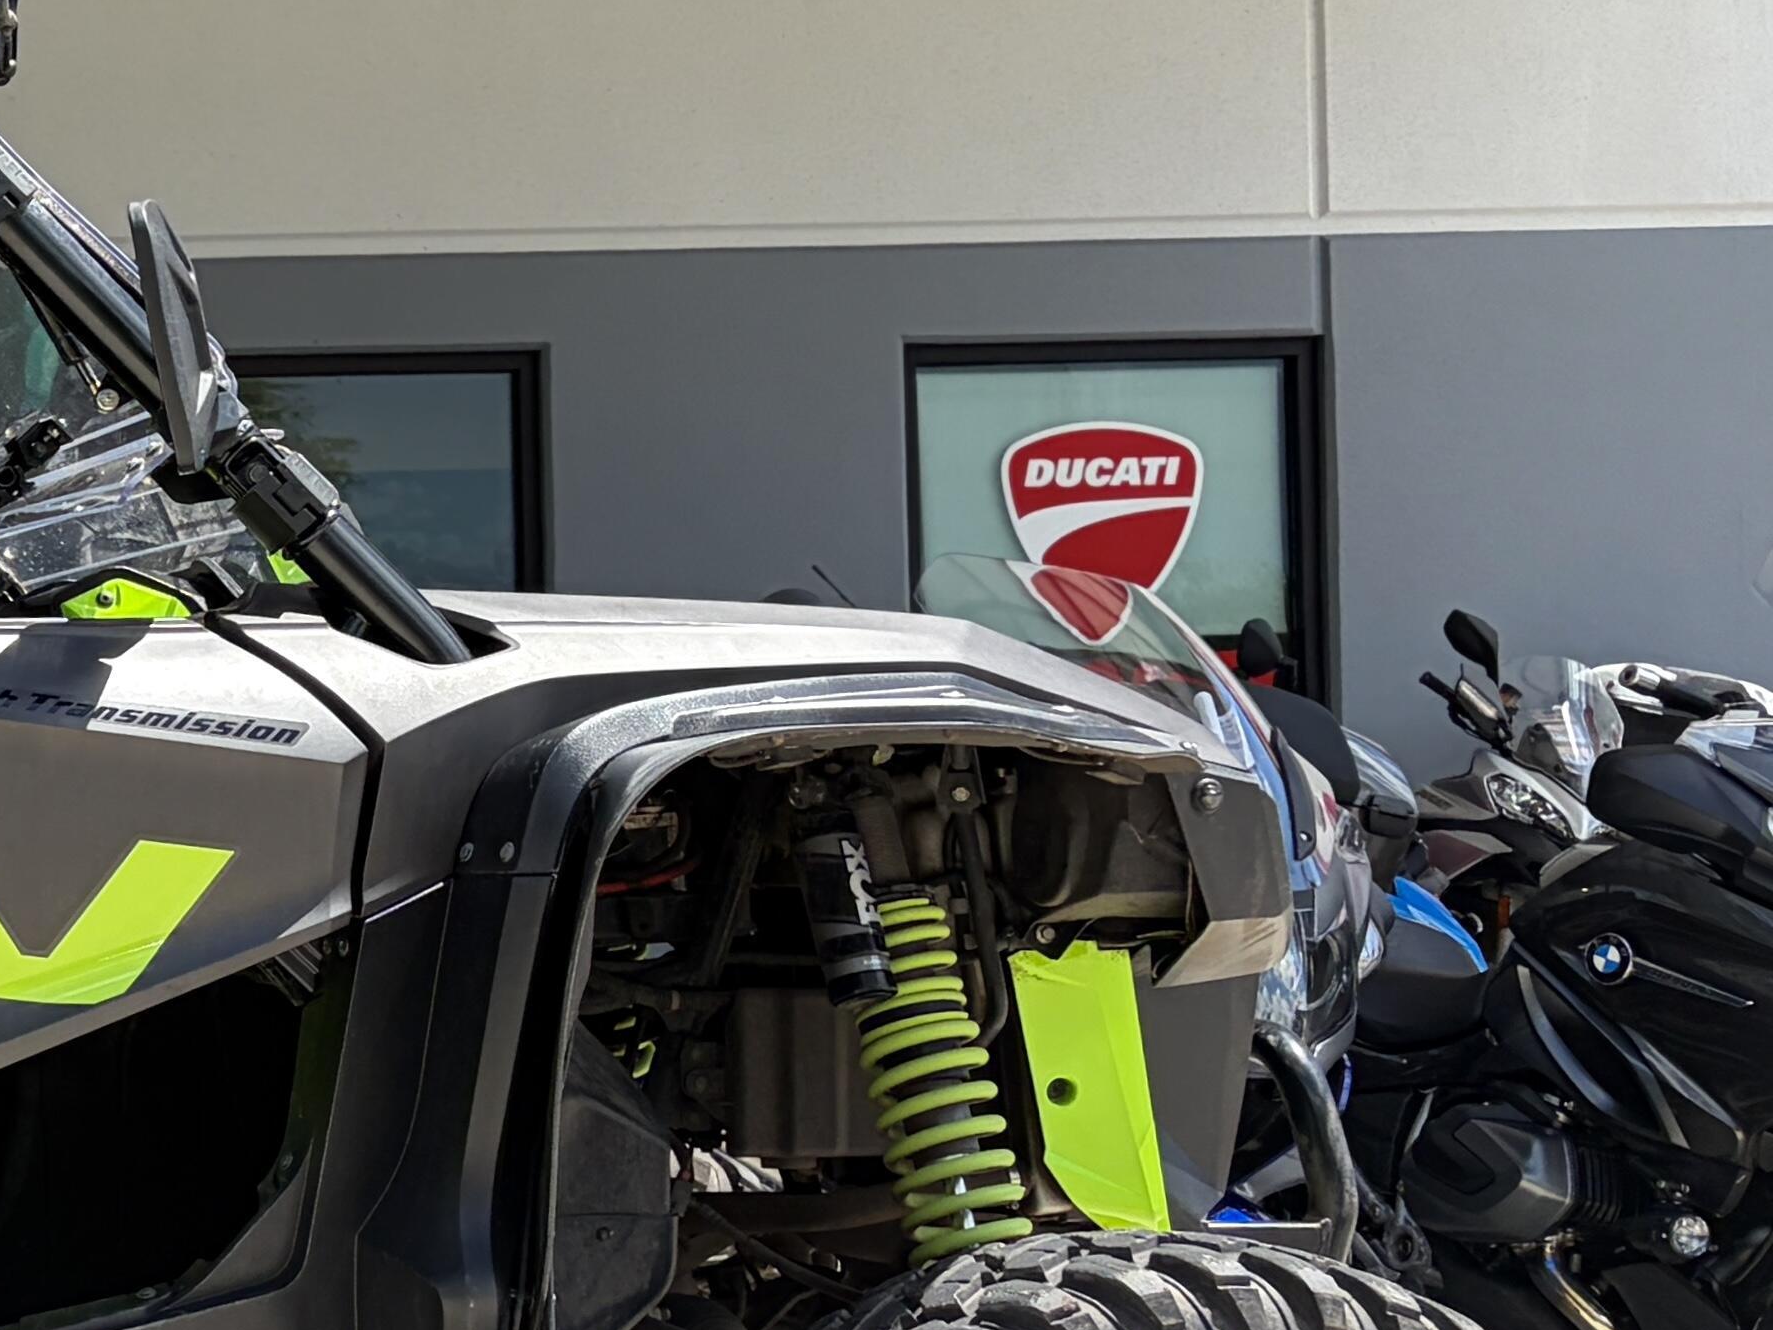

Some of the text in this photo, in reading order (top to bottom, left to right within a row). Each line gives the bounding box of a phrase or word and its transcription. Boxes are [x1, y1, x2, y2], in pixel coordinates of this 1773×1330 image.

[1024, 456, 1181, 488] DUCATI
[26, 692, 309, 746] Transmission
[841, 839, 885, 926] FOX
